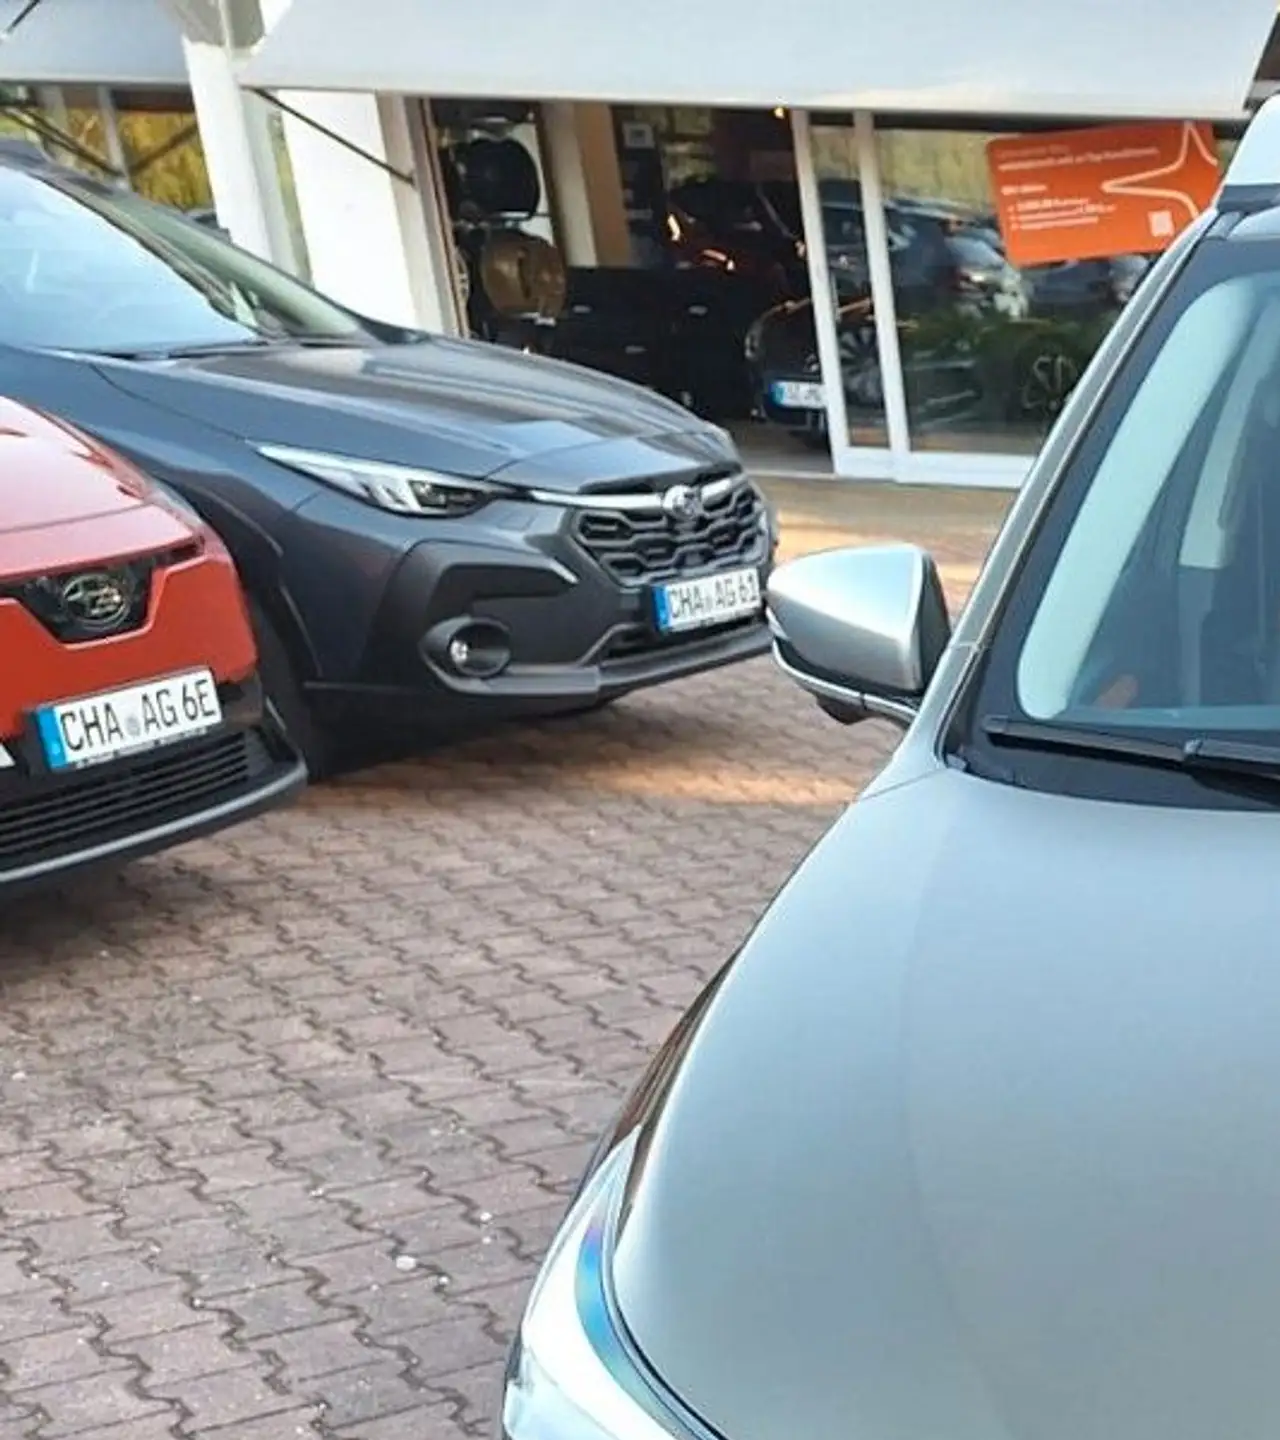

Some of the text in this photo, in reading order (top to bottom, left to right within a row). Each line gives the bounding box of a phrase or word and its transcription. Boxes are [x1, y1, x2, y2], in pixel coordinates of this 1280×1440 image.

[670, 573, 758, 619] CHA AG 61
[60, 679, 216, 752] CHA AG 6E
